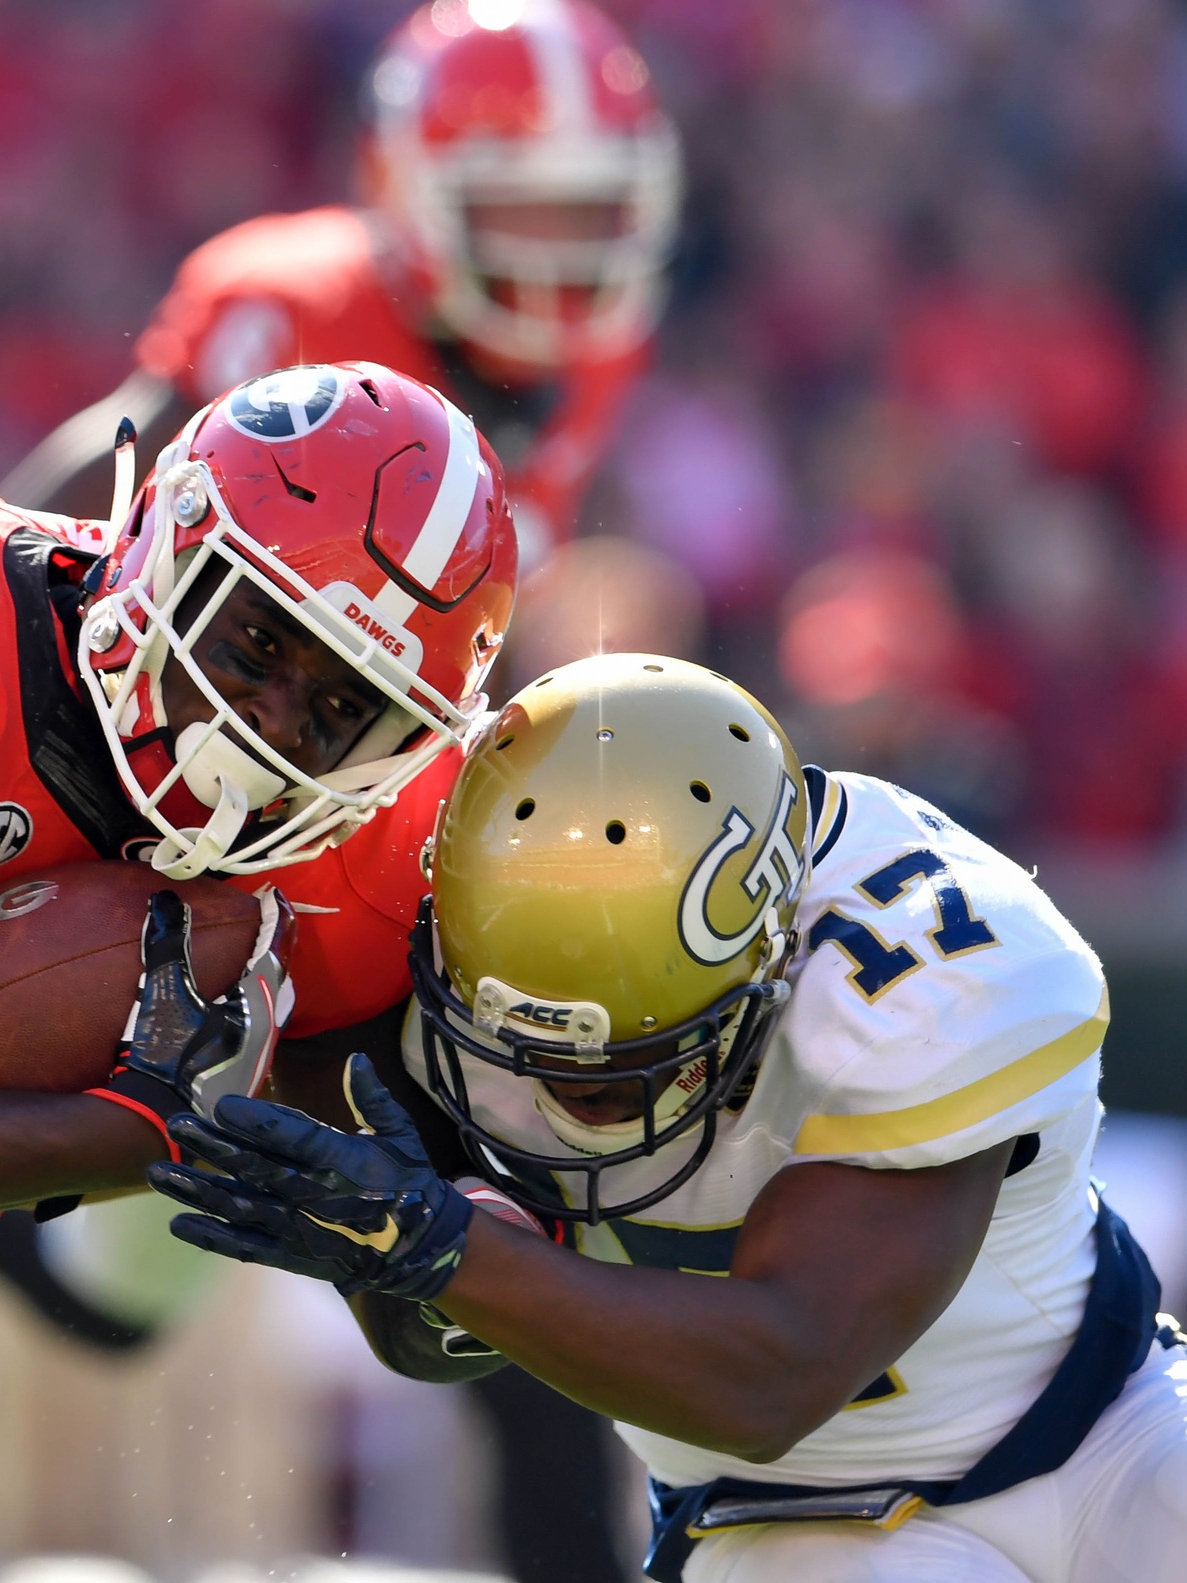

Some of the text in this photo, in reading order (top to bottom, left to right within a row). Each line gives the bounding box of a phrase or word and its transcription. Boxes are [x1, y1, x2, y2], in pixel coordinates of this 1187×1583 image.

[344, 602, 406, 657] DAWGS
[806, 846, 1003, 1006] 17
[509, 1002, 573, 1026] ACC
